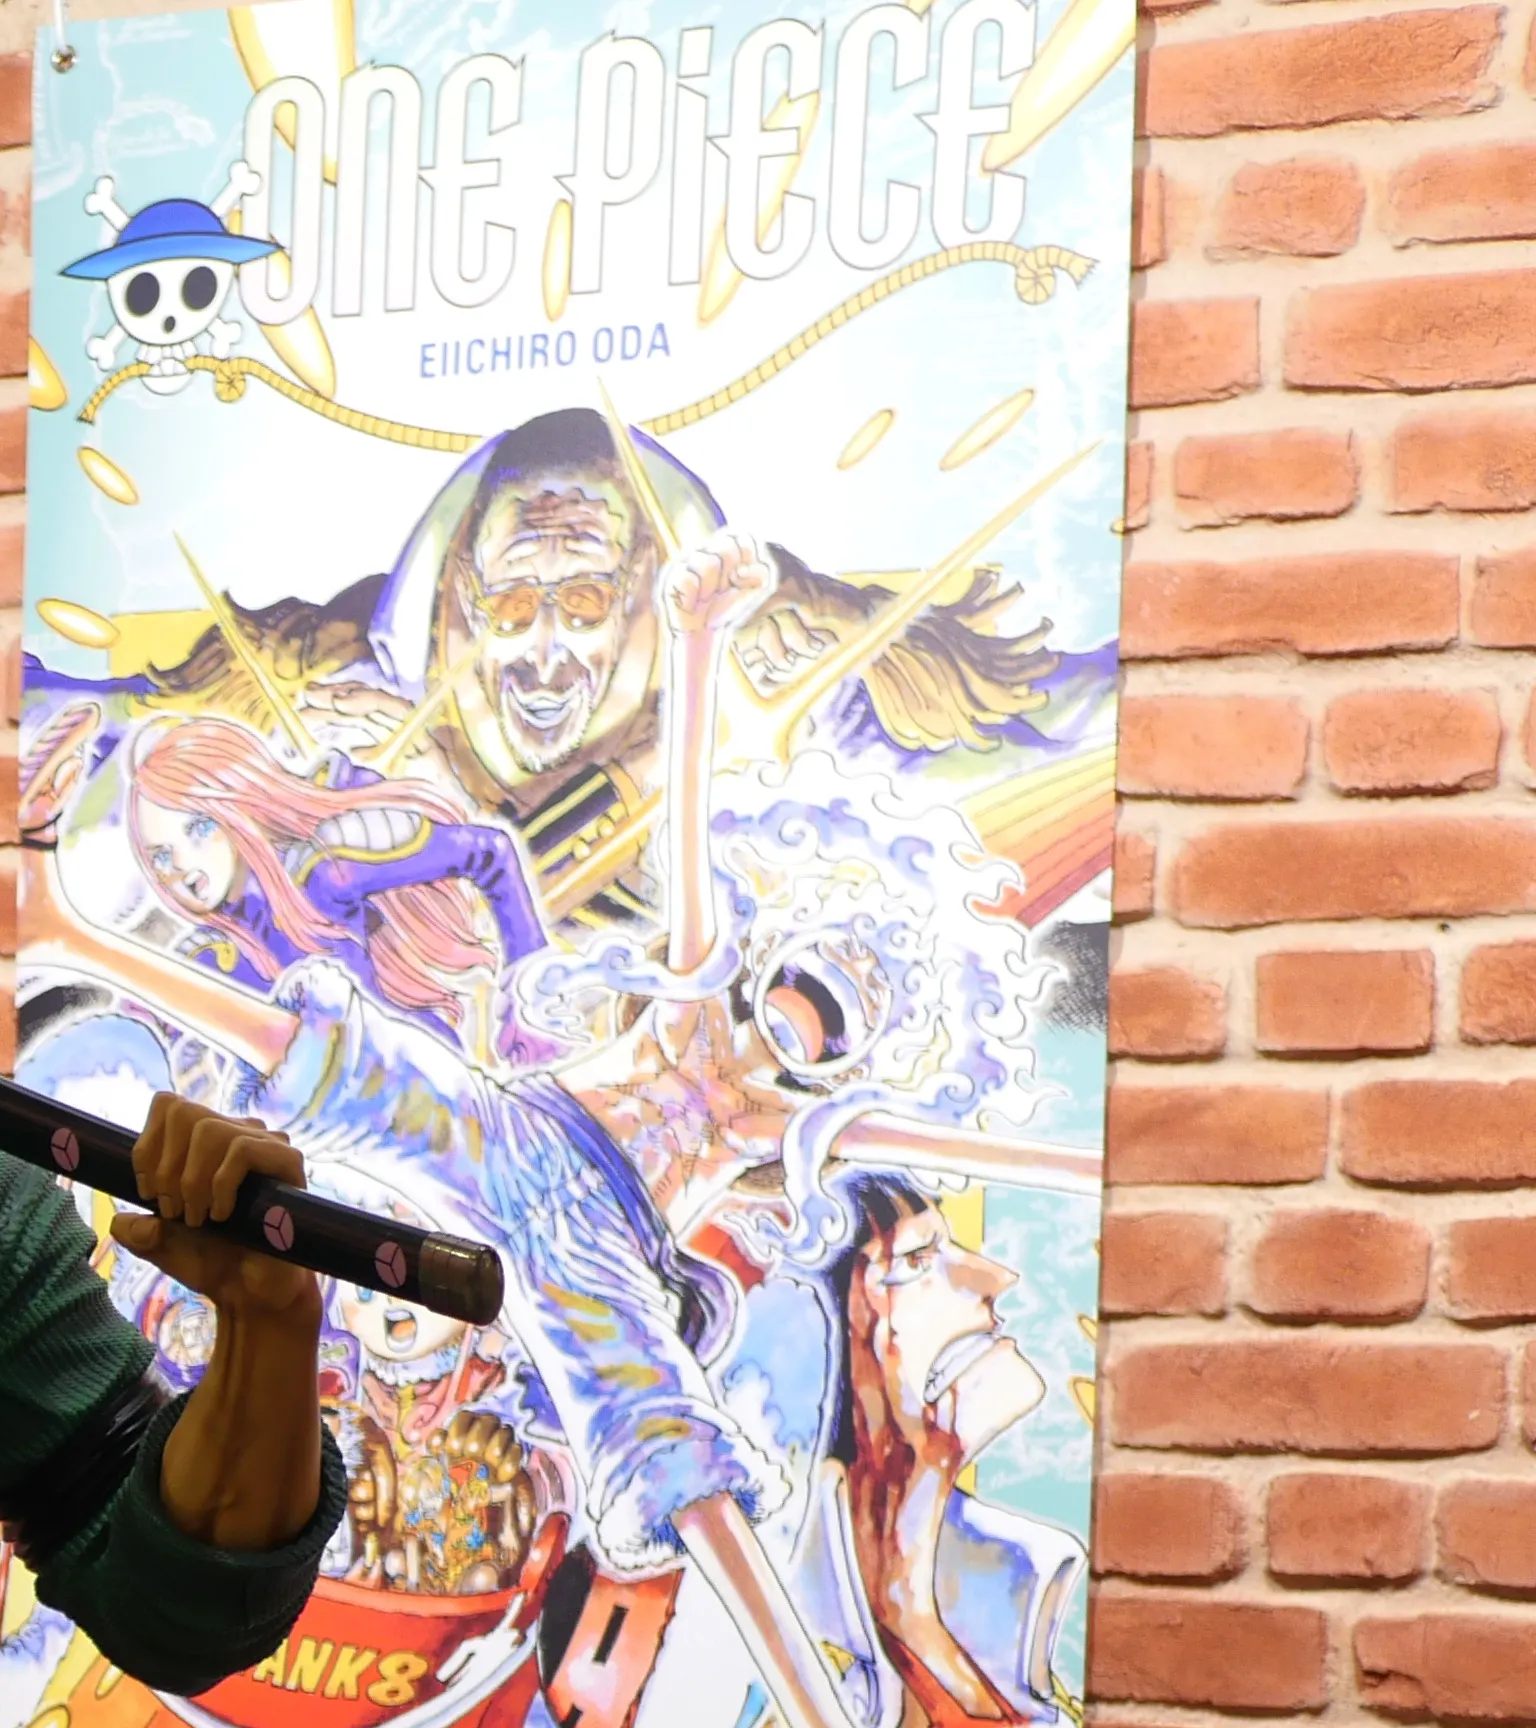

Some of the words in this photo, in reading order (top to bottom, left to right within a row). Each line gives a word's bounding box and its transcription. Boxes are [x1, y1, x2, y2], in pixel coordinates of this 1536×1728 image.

[238, 52, 525, 326] ONE
[419, 330, 578, 381] EIICHIRO
[590, 323, 673, 368] ODA
[250, 1634, 429, 1706] ANK8
